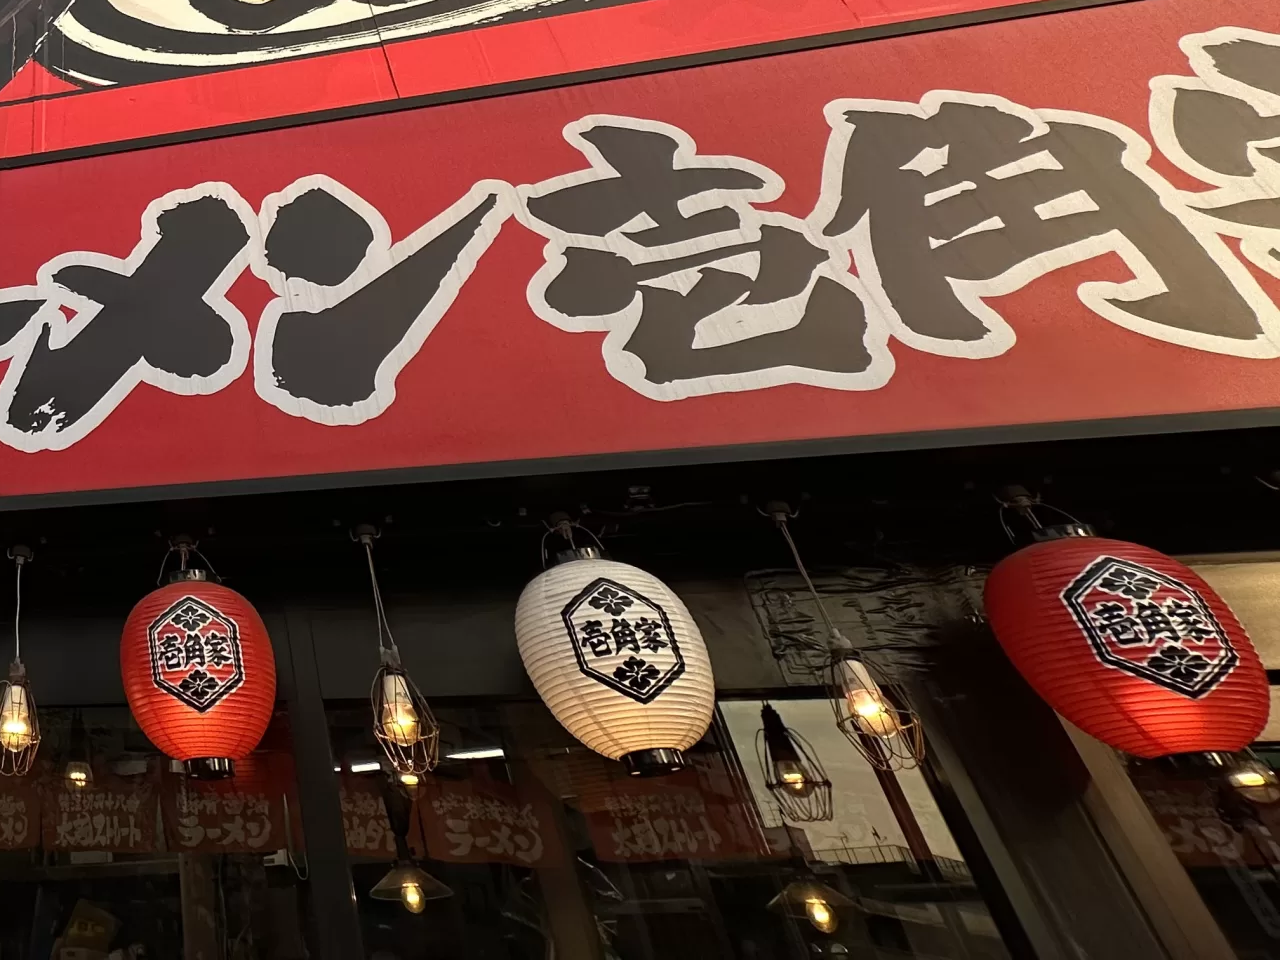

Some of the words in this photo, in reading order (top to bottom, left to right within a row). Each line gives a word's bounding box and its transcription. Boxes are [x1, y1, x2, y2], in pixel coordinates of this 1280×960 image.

[580, 616, 669, 657] 壱角家
[1090, 597, 1217, 646] 壱角家
[157, 630, 234, 670] 壱角家
[177, 815, 272, 848] ラーメン
[444, 818, 544, 864] ラーメン
